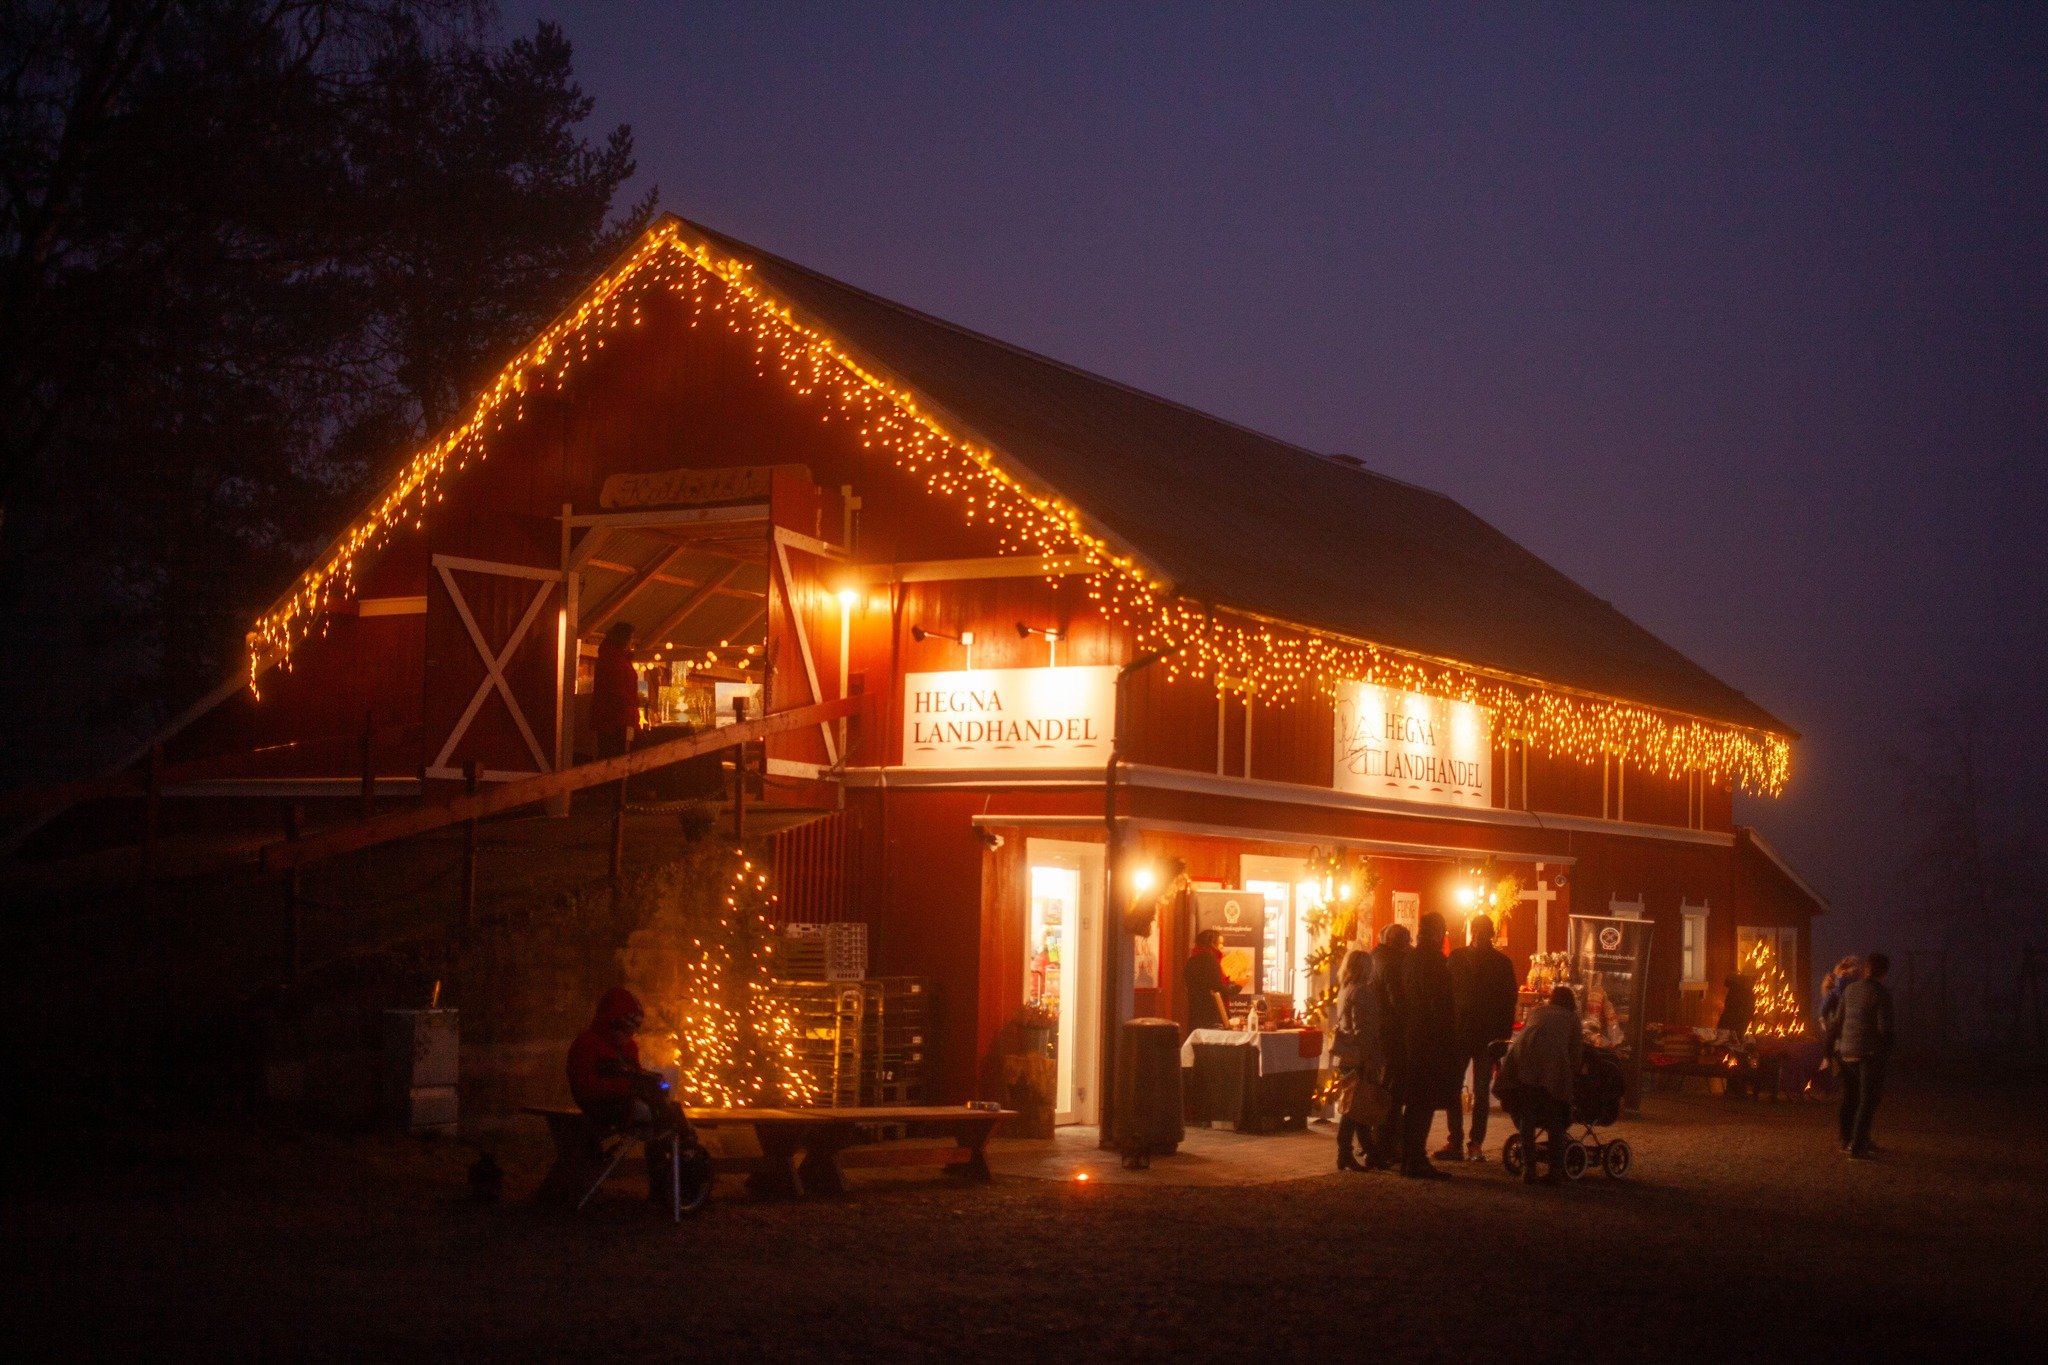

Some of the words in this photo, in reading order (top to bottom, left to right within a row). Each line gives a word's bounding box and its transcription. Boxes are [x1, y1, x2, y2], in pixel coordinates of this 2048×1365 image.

[915, 690, 1003, 712] HEGNA
[913, 718, 1098, 743] LANDHANDEL
[1385, 712, 1435, 746] HEGNA
[1384, 750, 1483, 788] LANDHANDEL
